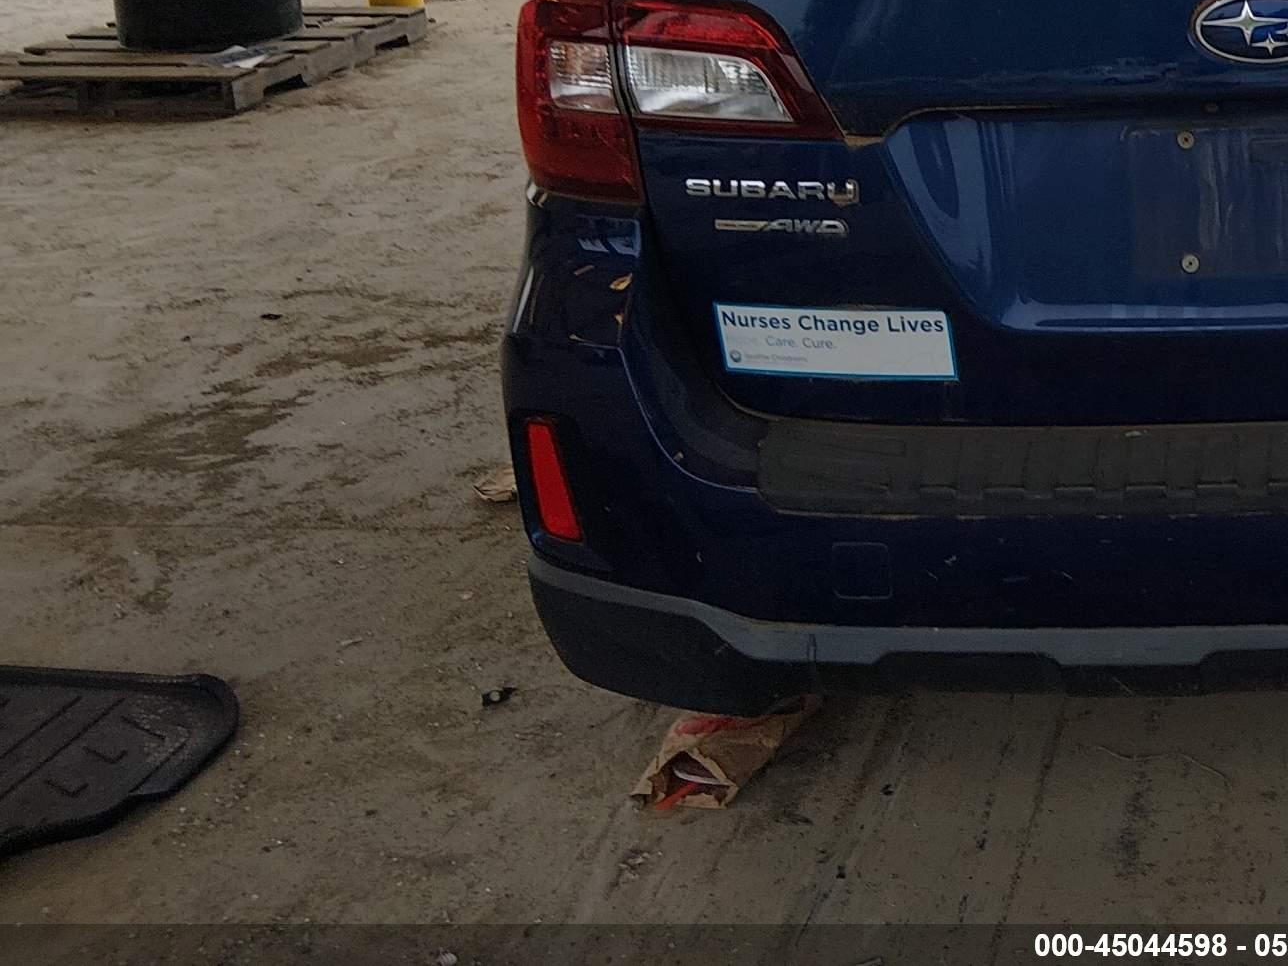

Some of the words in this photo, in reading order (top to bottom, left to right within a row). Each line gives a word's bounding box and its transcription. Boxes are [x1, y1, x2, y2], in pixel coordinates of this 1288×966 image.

[685, 178, 857, 202] SUBARU
[768, 218, 847, 234] AWD
[721, 310, 792, 330] Nurses
[798, 314, 880, 335] Change
[887, 316, 945, 333] Lives
[802, 337, 837, 350] Cure.
